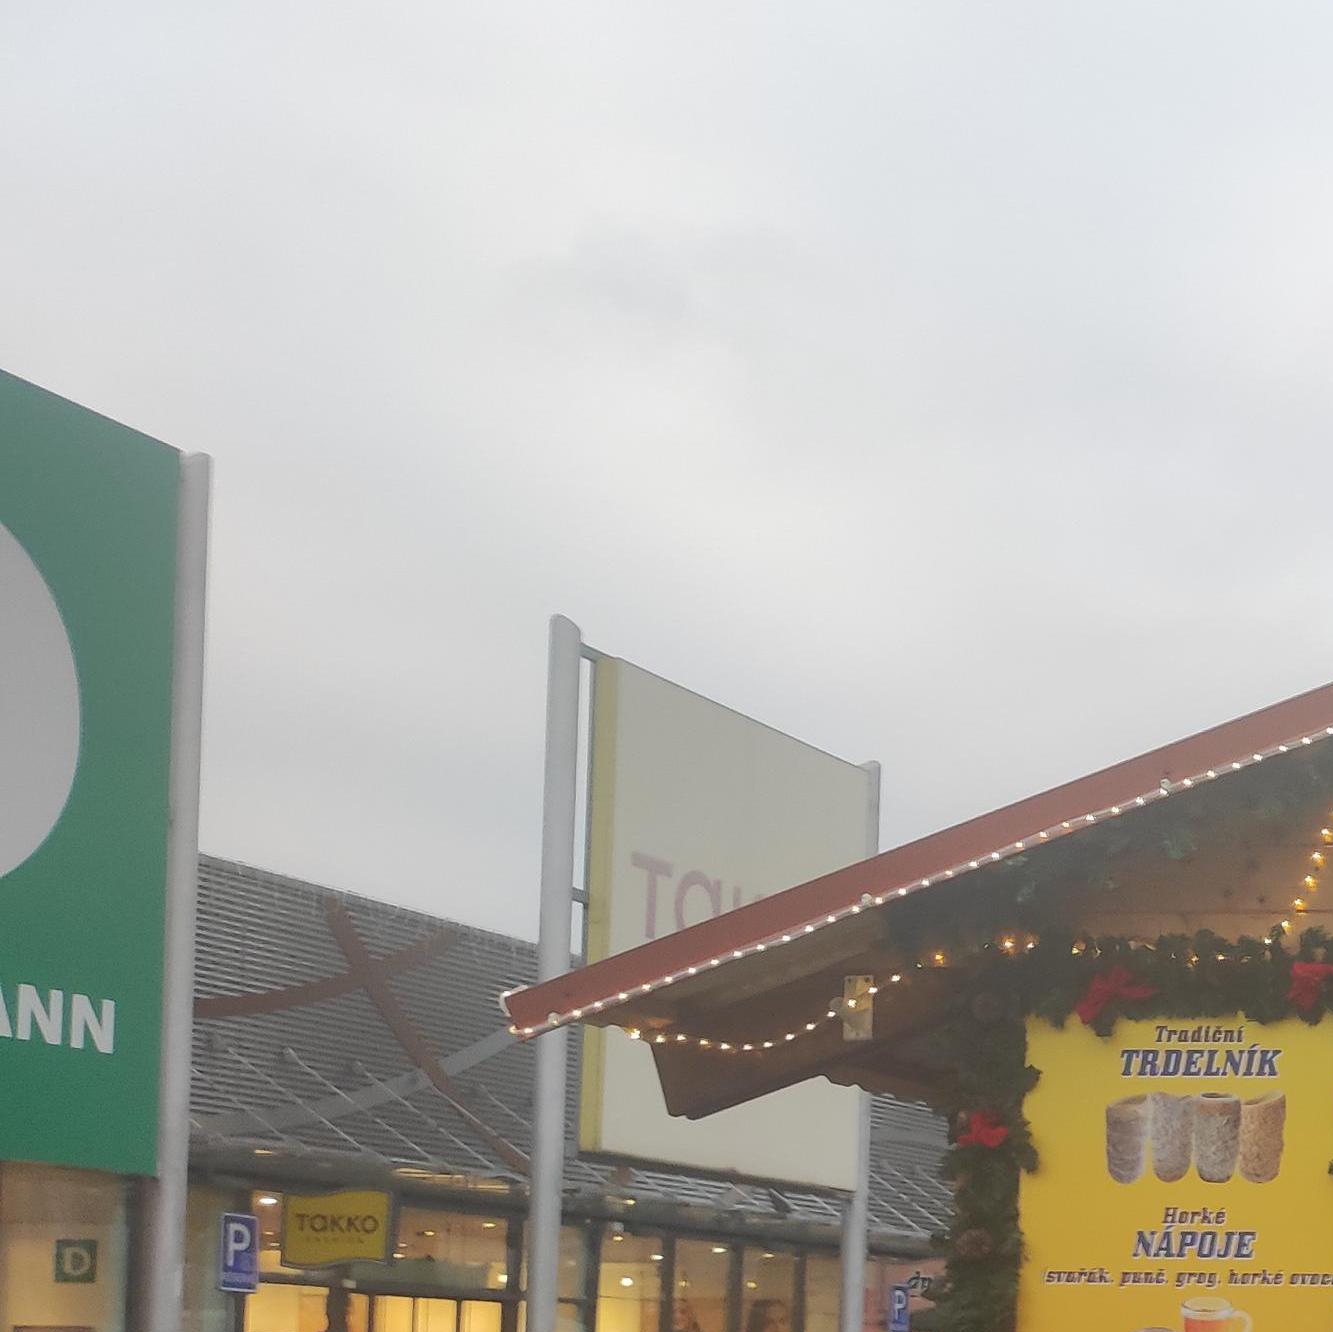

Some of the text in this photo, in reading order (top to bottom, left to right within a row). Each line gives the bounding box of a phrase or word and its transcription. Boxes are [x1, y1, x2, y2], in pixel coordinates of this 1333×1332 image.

[1155, 1025, 1246, 1044] Tradiční
[1120, 1043, 1283, 1077] TRDELNÍK
[295, 1213, 380, 1234] TAKKO
[1162, 1207, 1226, 1224] Horké
[227, 1221, 251, 1267] P
[1132, 1225, 1257, 1259] NÁPOJE
[1228, 1268, 1284, 1286] horké
